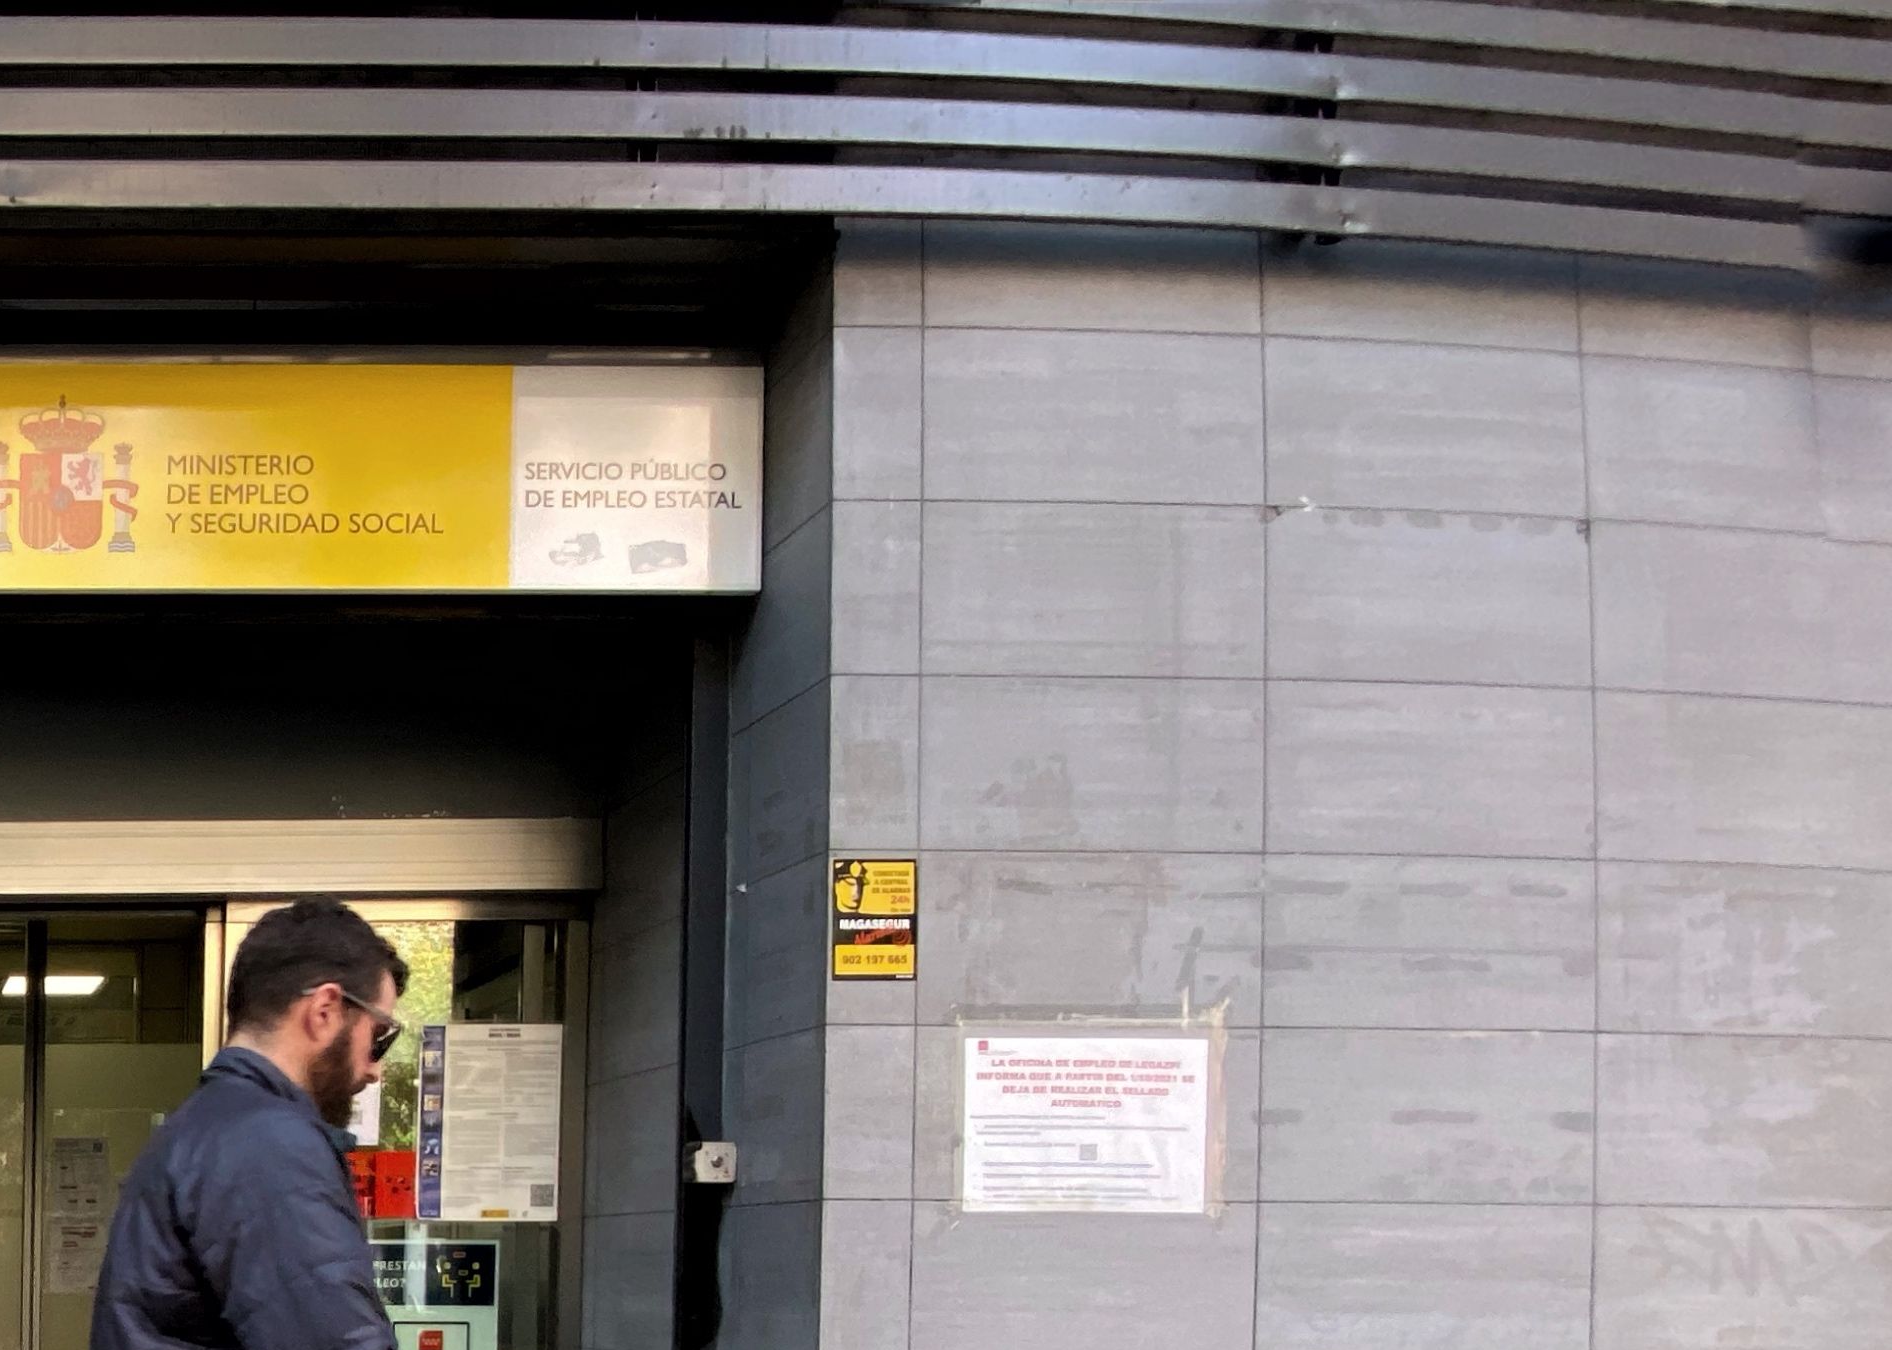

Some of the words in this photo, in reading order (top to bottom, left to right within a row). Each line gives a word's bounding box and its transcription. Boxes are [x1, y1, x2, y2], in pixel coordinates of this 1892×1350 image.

[166, 454, 314, 477] MINISTERIO
[524, 461, 623, 482] SERVICIO
[630, 456, 728, 482] PÚBLICO
[167, 483, 203, 505] DE
[210, 483, 309, 506] EMPLEO
[525, 490, 555, 509] DE
[562, 490, 648, 510] EMPLEO
[654, 490, 742, 510] ESTATAL
[167, 513, 180, 534] Y
[189, 512, 341, 535] SEGURIDAD
[348, 512, 444, 535] SOCIAL
[842, 955, 862, 965] 902
[1029, 1073, 1052, 1081] QUE
